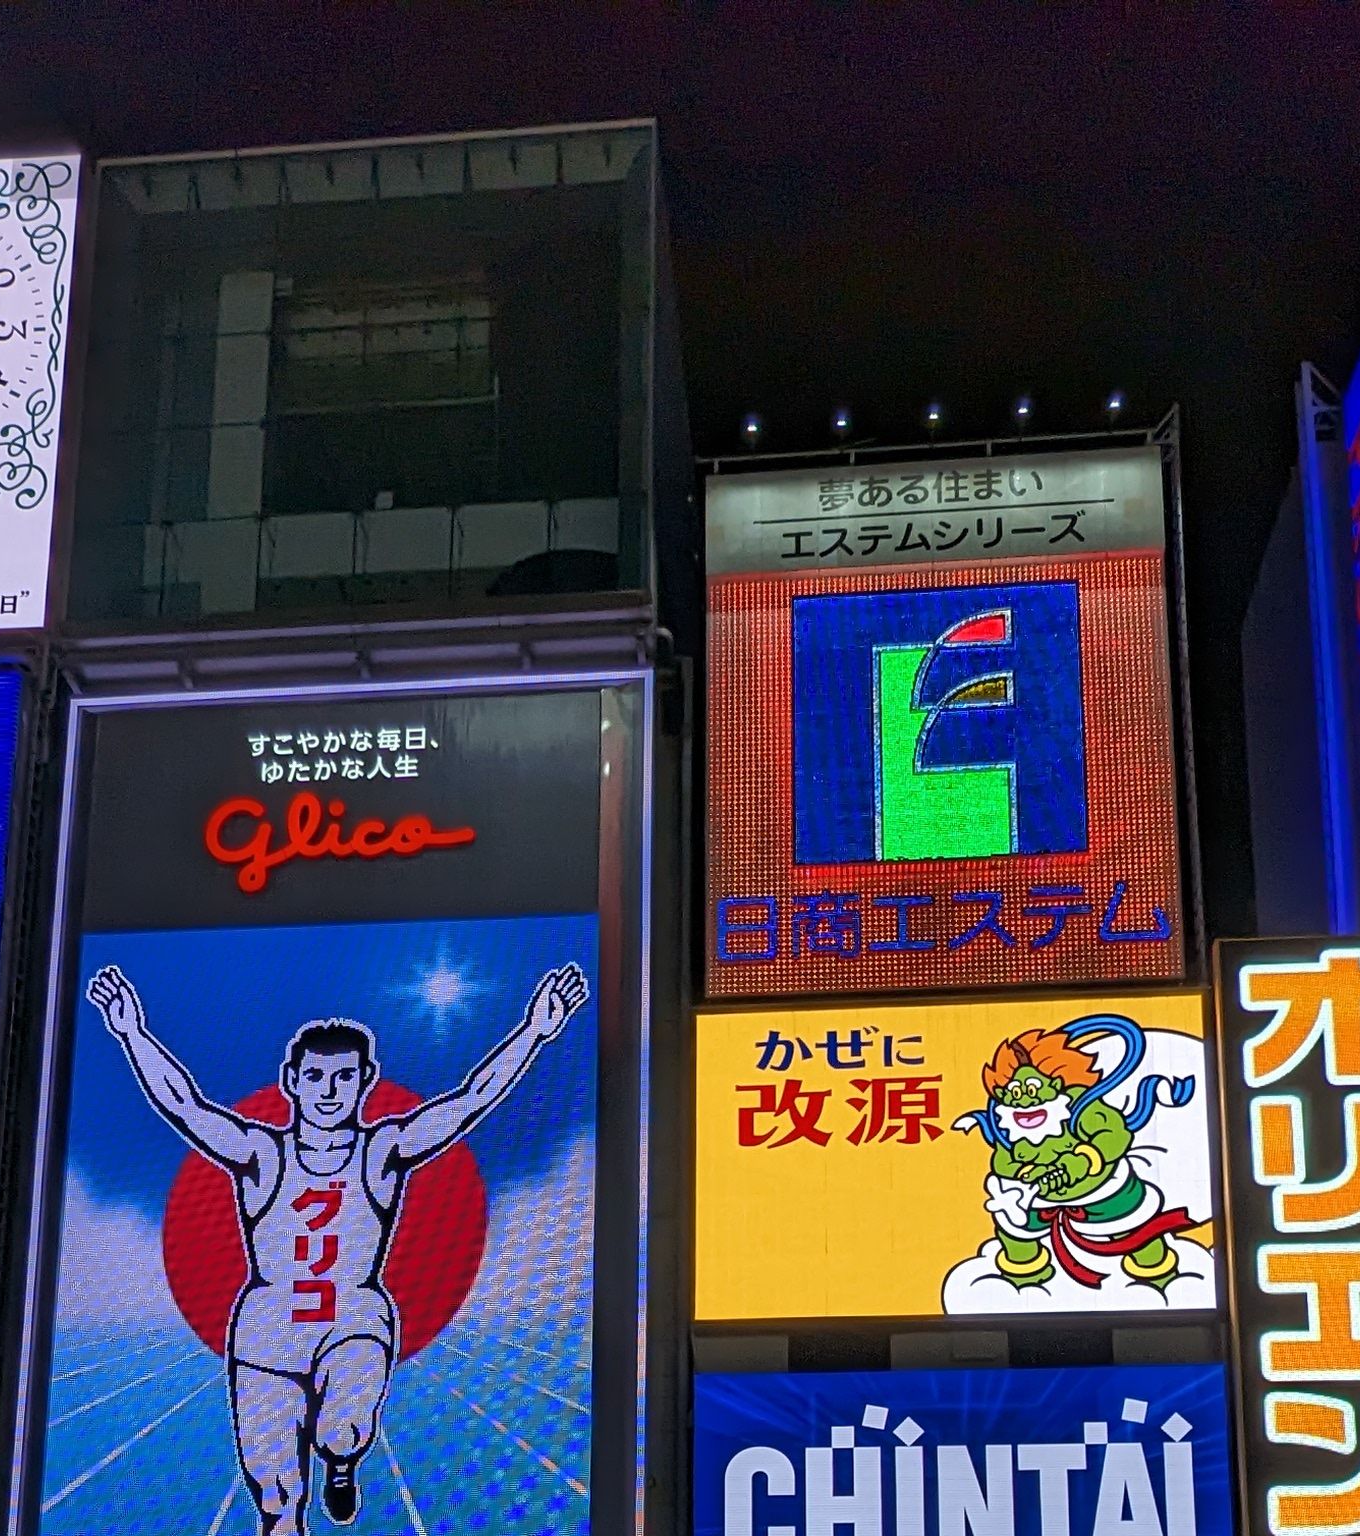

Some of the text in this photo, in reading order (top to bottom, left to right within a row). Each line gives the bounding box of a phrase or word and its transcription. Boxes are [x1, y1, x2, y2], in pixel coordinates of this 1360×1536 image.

[818, 469, 1044, 512] 夢ある住まい
[781, 510, 1086, 559] エステムシリーズ
[248, 727, 439, 757] すこやかな毎日、
[261, 755, 419, 784] ゆたかな人生
[205, 792, 477, 893] Glico
[716, 881, 1173, 962] 日商エステム
[755, 1025, 926, 1072] かぜに
[735, 1075, 944, 1149] 改源
[290, 1181, 347, 1322] グリコ
